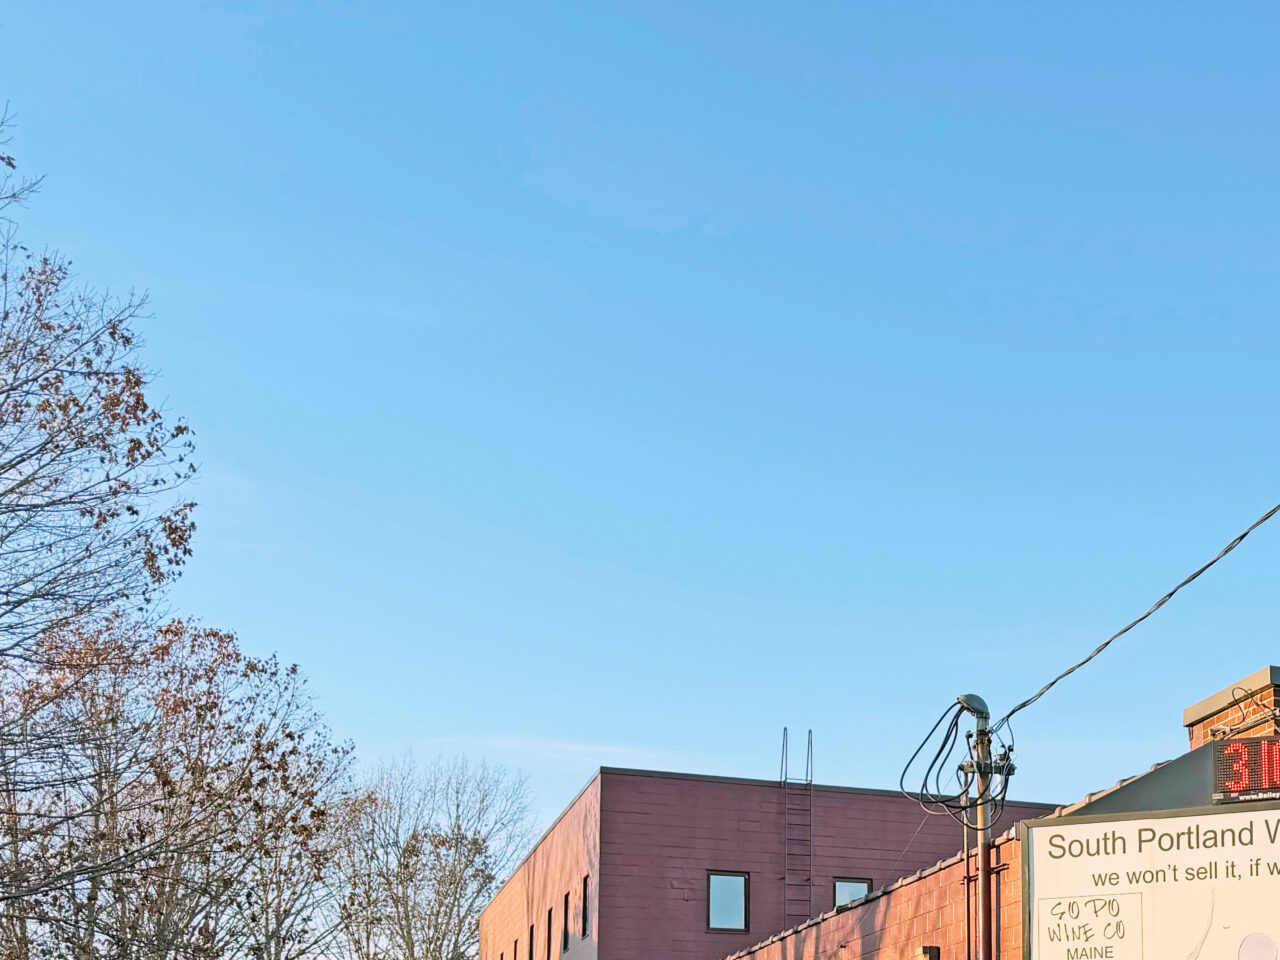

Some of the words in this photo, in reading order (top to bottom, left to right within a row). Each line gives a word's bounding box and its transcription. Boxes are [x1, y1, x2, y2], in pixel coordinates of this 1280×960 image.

[1048, 830, 1127, 859] South
[1138, 820, 1254, 854] Portland
[1092, 872, 1120, 887] we
[1126, 863, 1179, 884] won’t
[1185, 861, 1218, 881] sell
[1225, 860, 1242, 881] it,
[1249, 858, 1261, 877] if
[1084, 898, 1120, 918] PO
[1047, 922, 1095, 942] WINE
[1103, 920, 1125, 939] CO
[1066, 945, 1114, 960] MAINE
